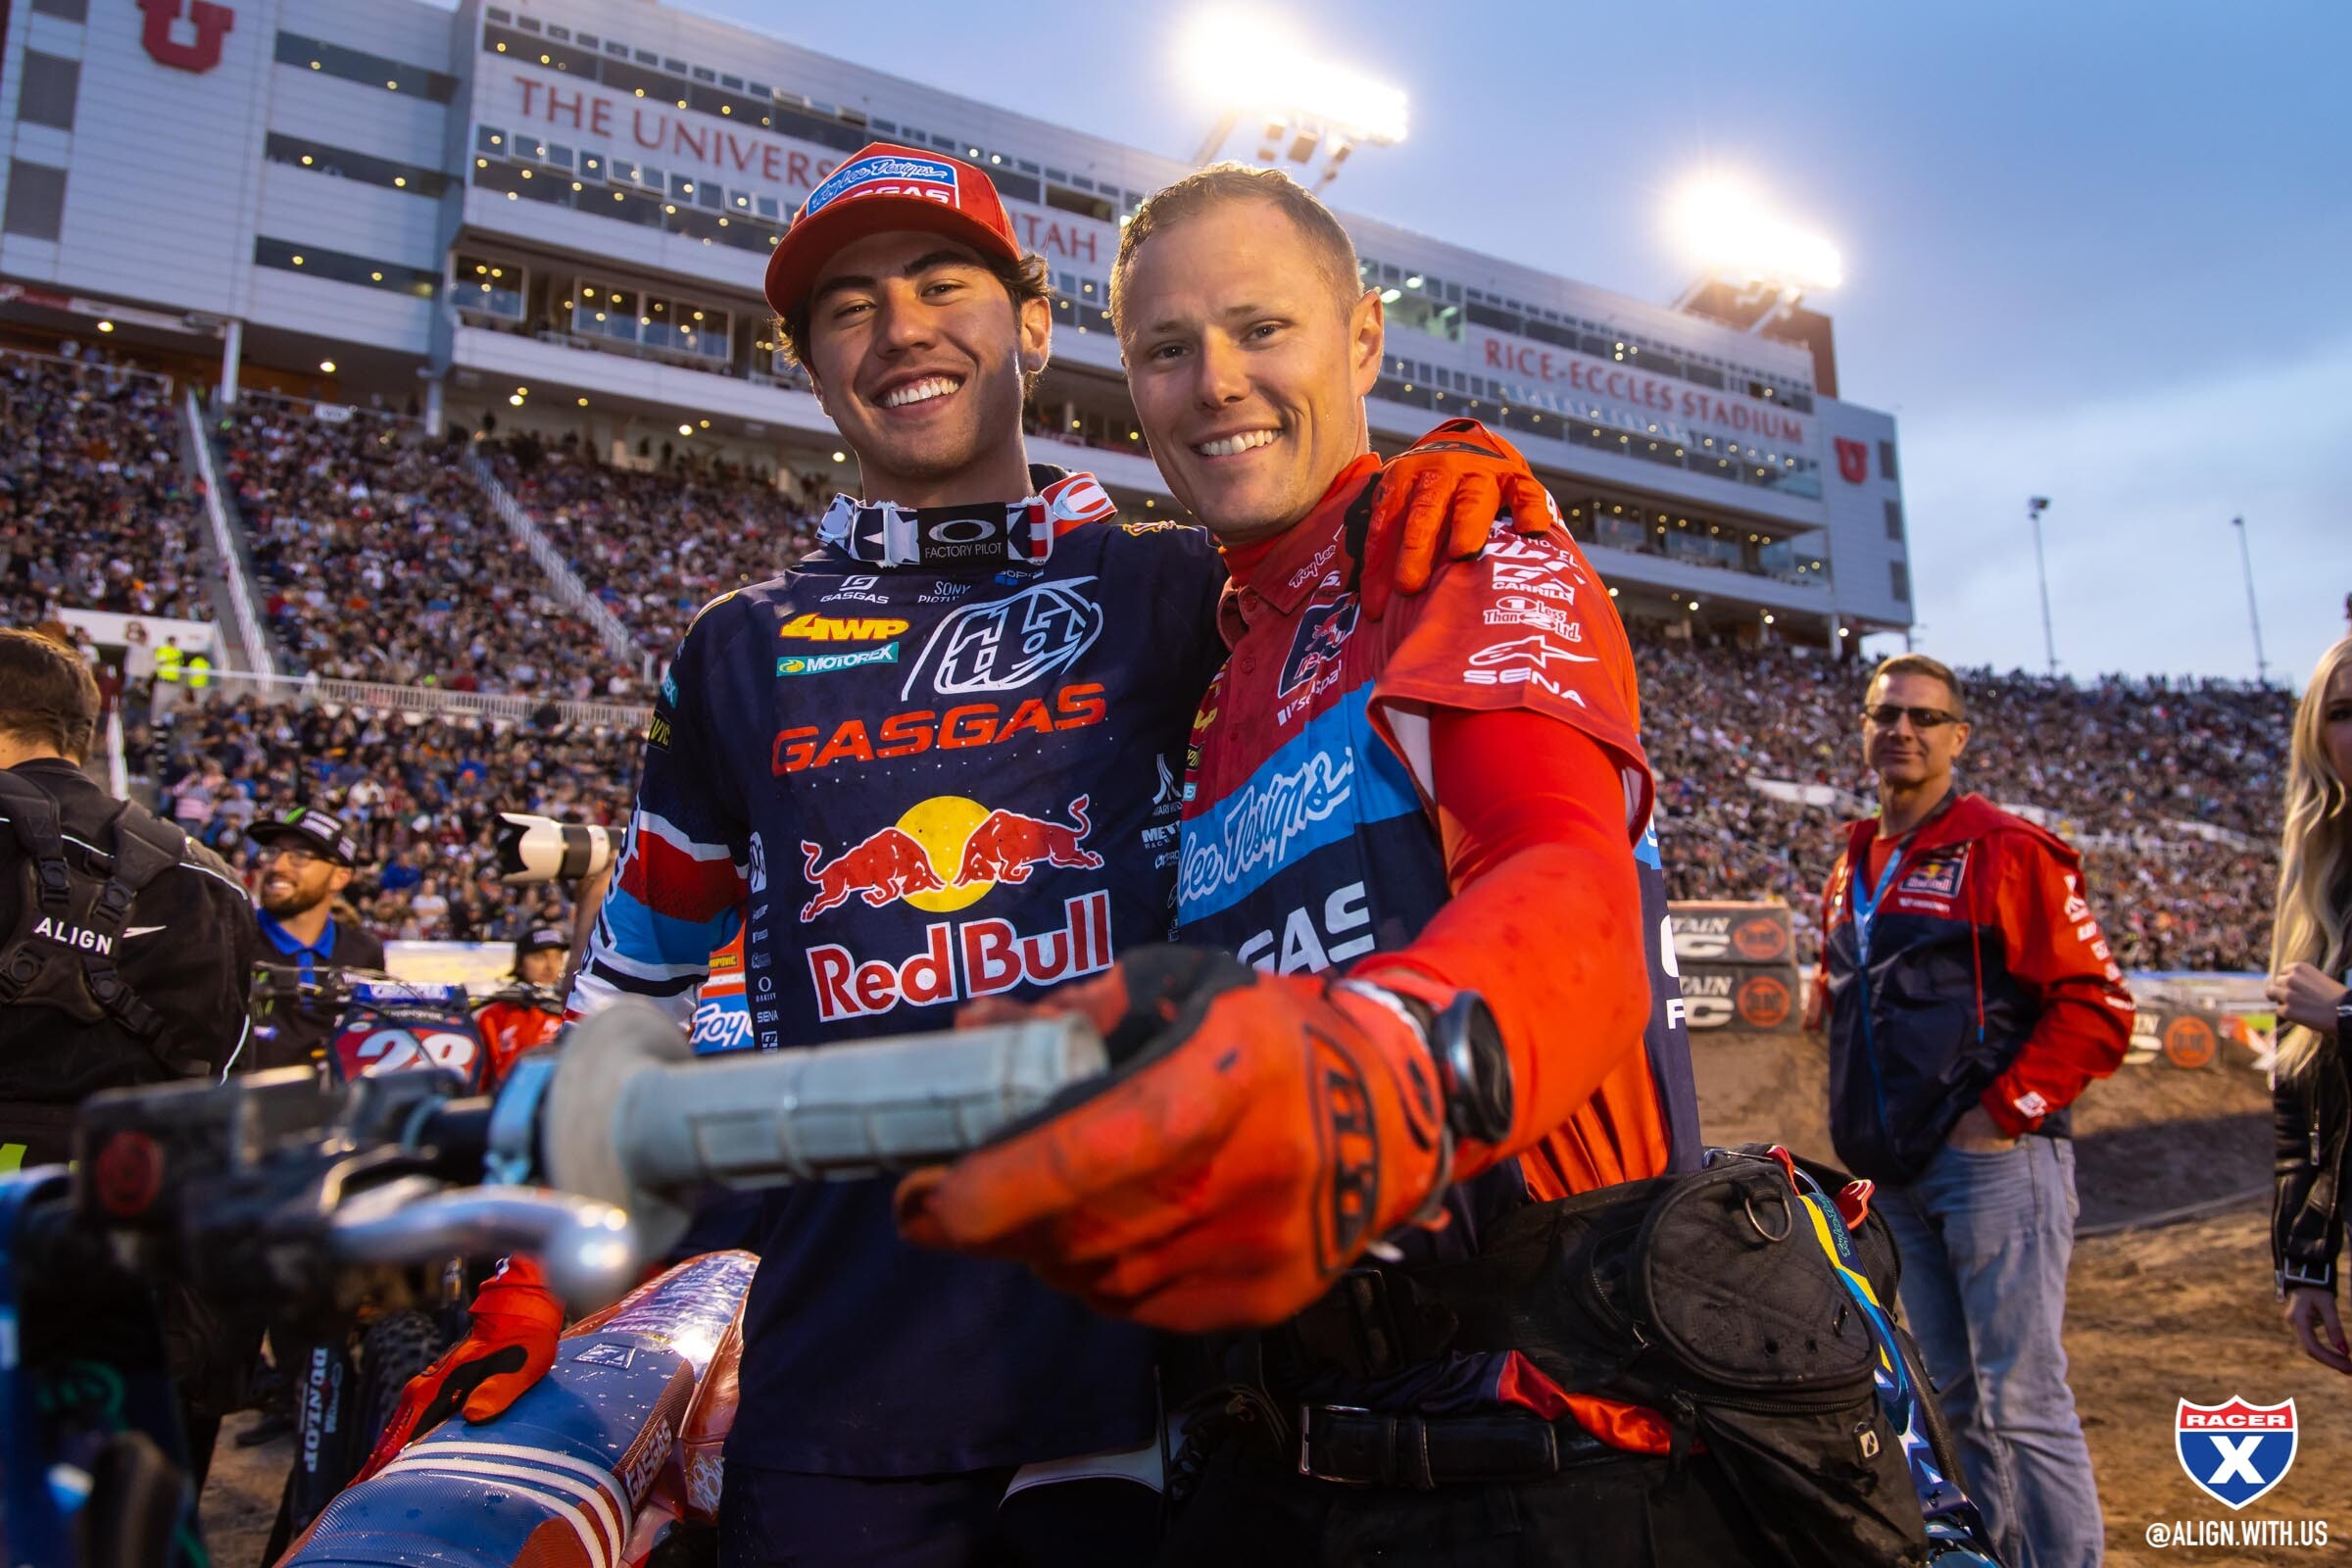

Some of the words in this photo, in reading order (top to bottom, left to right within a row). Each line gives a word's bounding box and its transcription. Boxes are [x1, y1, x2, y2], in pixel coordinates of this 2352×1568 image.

[514, 75, 613, 138] THE
[1012, 210, 1097, 264] TAH
[870, 159, 948, 178] Designs
[1485, 338, 1674, 412] RICE-ECCLES
[1683, 391, 1803, 444] STADIUM
[924, 544, 973, 559] FACTORY
[975, 542, 1002, 555] PILOT
[1288, 563, 1318, 589] Troy
[1315, 545, 1337, 566] Lee
[819, 591, 890, 605] GASGAS
[934, 580, 971, 595] SONY
[1483, 608, 1518, 624] Than
[1536, 600, 1567, 623] Less
[806, 644, 894, 673] MOTOREX
[1463, 667, 1586, 708] SENA
[771, 682, 1107, 777] GASGAS
[33, 916, 114, 956] ALIGN
[806, 922, 958, 1022] Red
[958, 888, 1114, 999] Bull
[757, 1008, 779, 1023] SENA
[303, 1347, 328, 1473] DUNLOP
[624, 1418, 674, 1506] GASGAS
